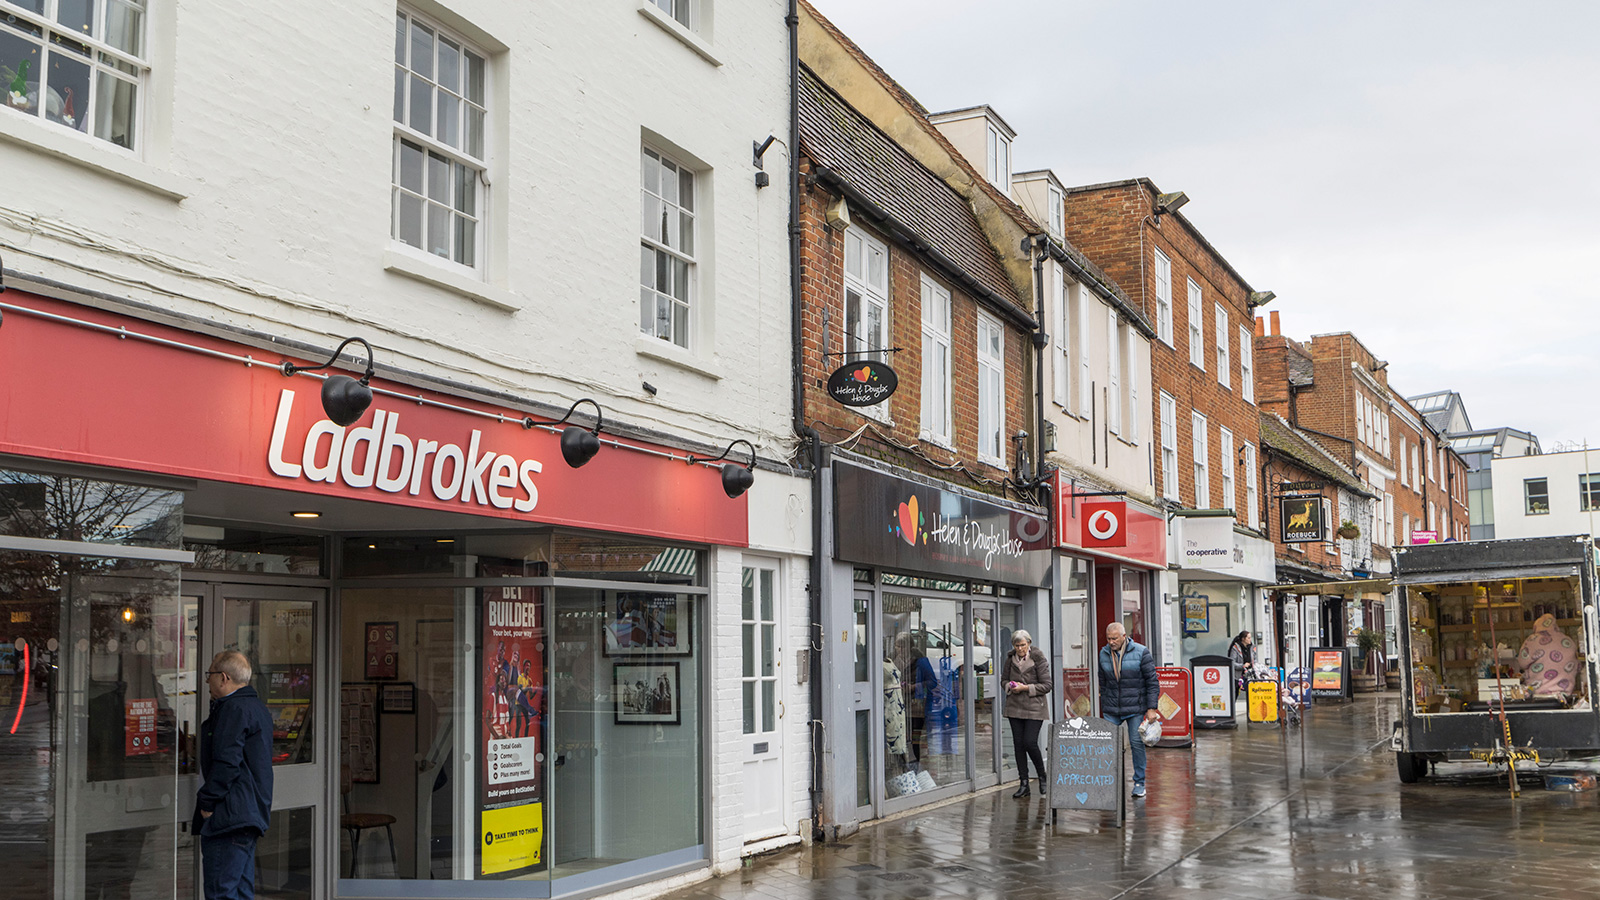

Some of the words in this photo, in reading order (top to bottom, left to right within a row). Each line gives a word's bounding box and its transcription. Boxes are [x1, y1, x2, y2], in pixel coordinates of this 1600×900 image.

[835, 386, 856, 394] Helen
[857, 384, 863, 395] &
[864, 384, 888, 398] Douglas
[851, 394, 872, 402] House
[268, 388, 543, 513] Ladbrokes
[931, 512, 961, 547] Helen
[963, 515, 970, 555] &
[971, 520, 1001, 571] Douglas
[1001, 529, 1024, 558] House
[1287, 531, 1317, 539] ROEBUCK
[1186, 548, 1228, 557] co-operative
[502, 574, 522, 600] BET
[488, 601, 536, 628] BUILDER
[493, 629, 503, 637] Your
[513, 630, 523, 638] your
[1206, 671, 1218, 680] £4
[1060, 757, 1113, 770] GREATLY
[1056, 773, 1114, 786] APPRECIATED
[499, 789, 510, 797] yours
[494, 832, 506, 840] TAKE
[507, 830, 518, 838] TIME
[525, 827, 539, 835] THINK
